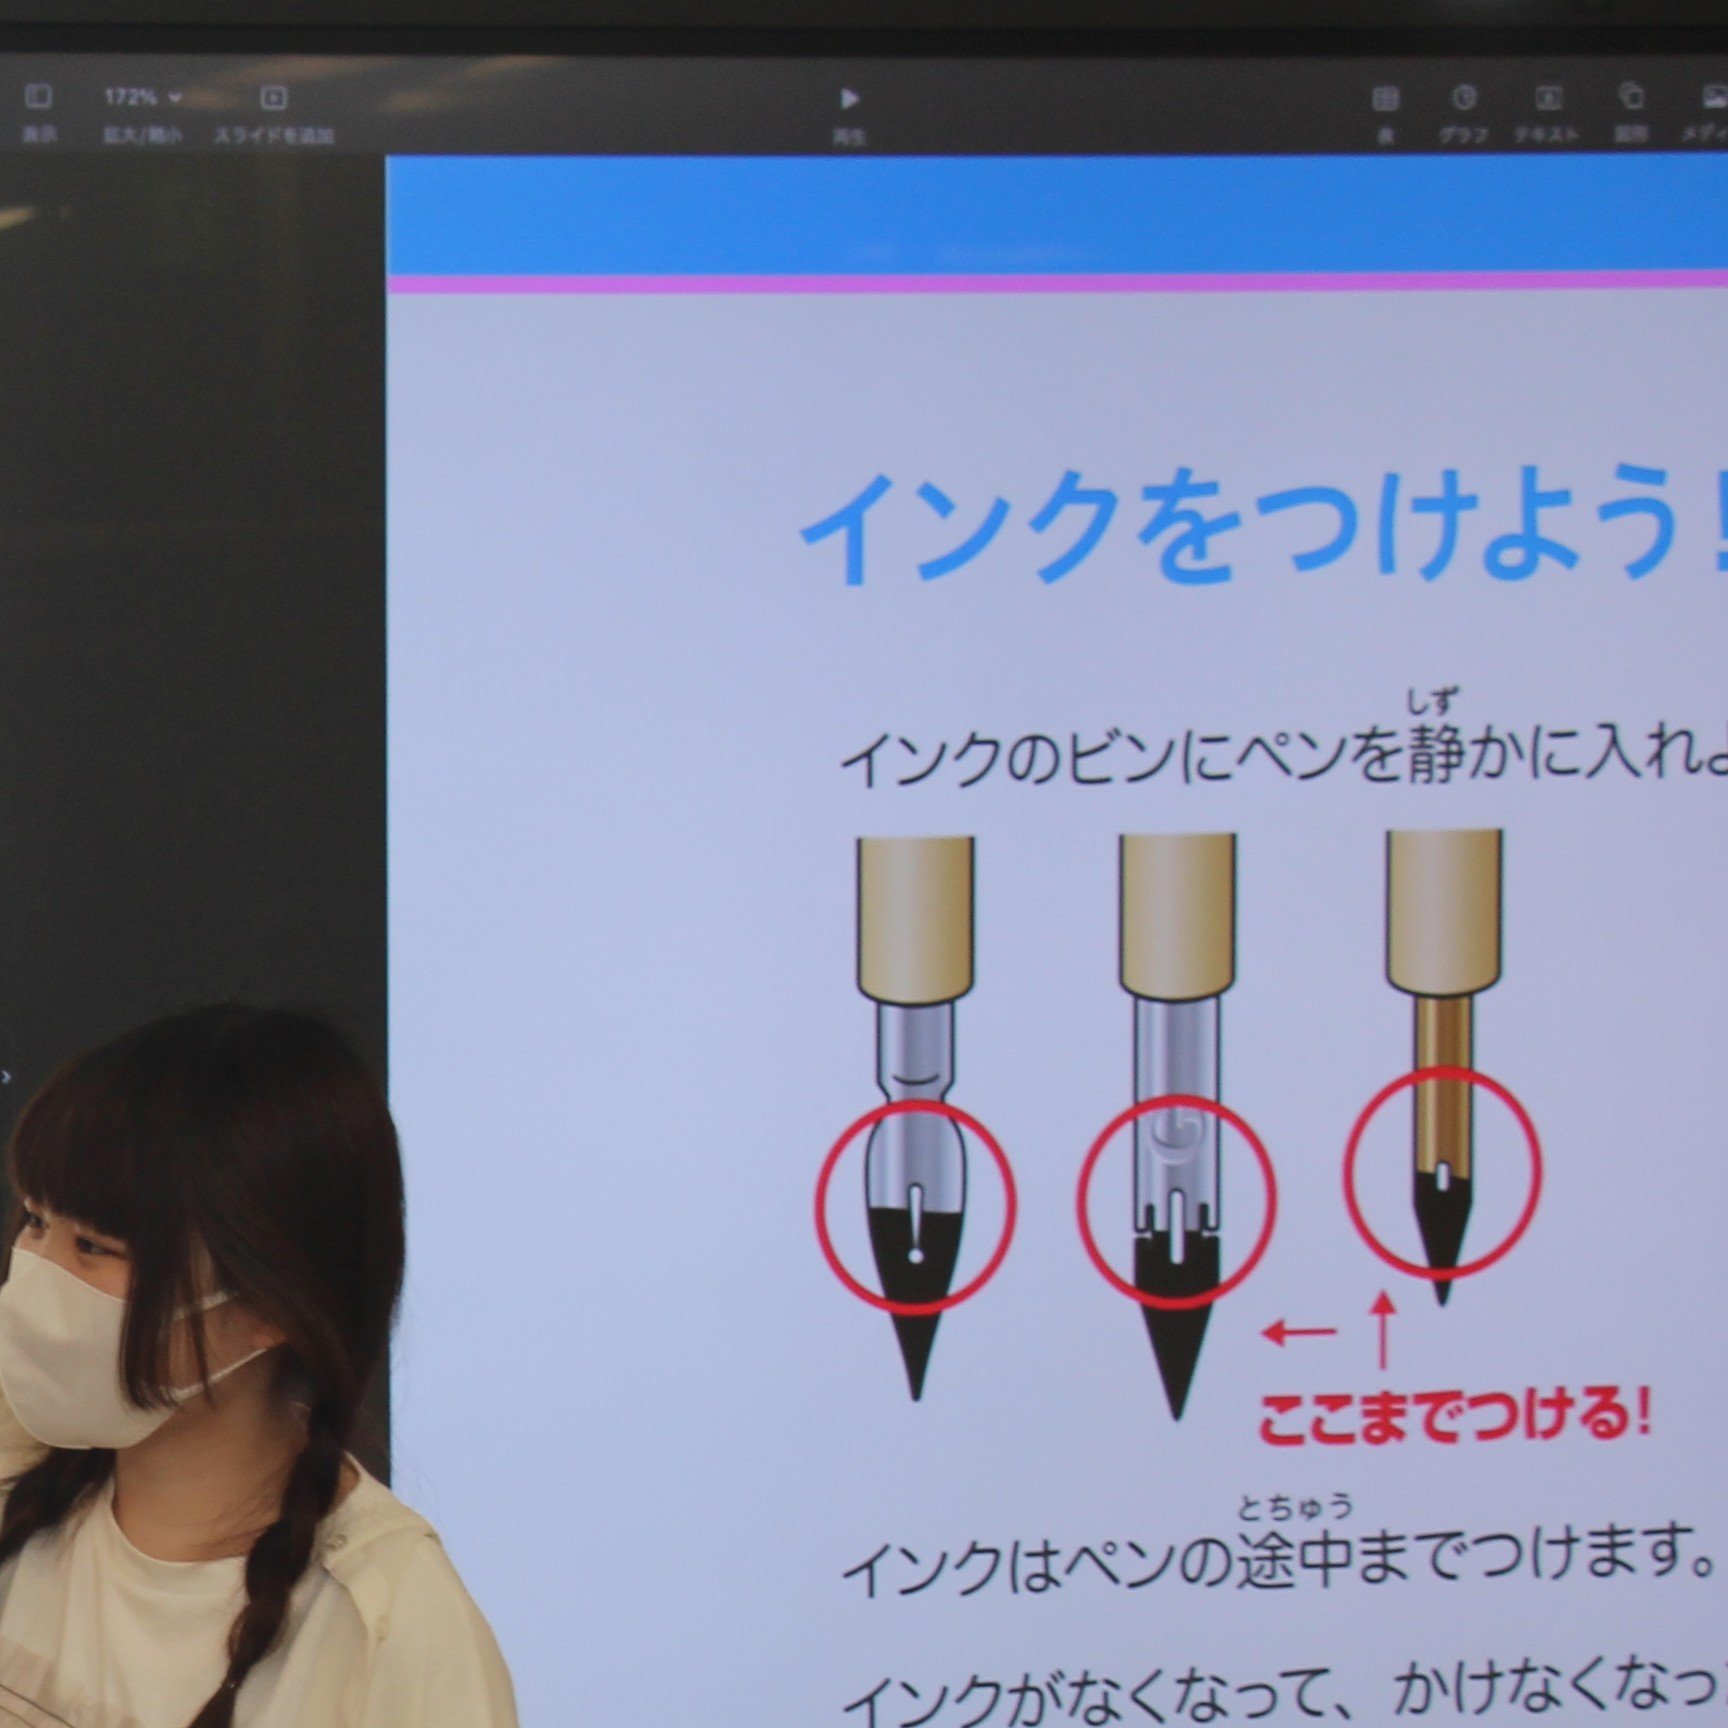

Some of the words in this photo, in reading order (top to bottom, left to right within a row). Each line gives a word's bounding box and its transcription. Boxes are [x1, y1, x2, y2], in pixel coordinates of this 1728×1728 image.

[1408, 686, 1461, 717] しず
[1259, 1385, 1652, 1448] ここまでつける!
[1239, 1494, 1354, 1523] とちゅう
[843, 1519, 1715, 1600] インクはペンの途中までつけます。
